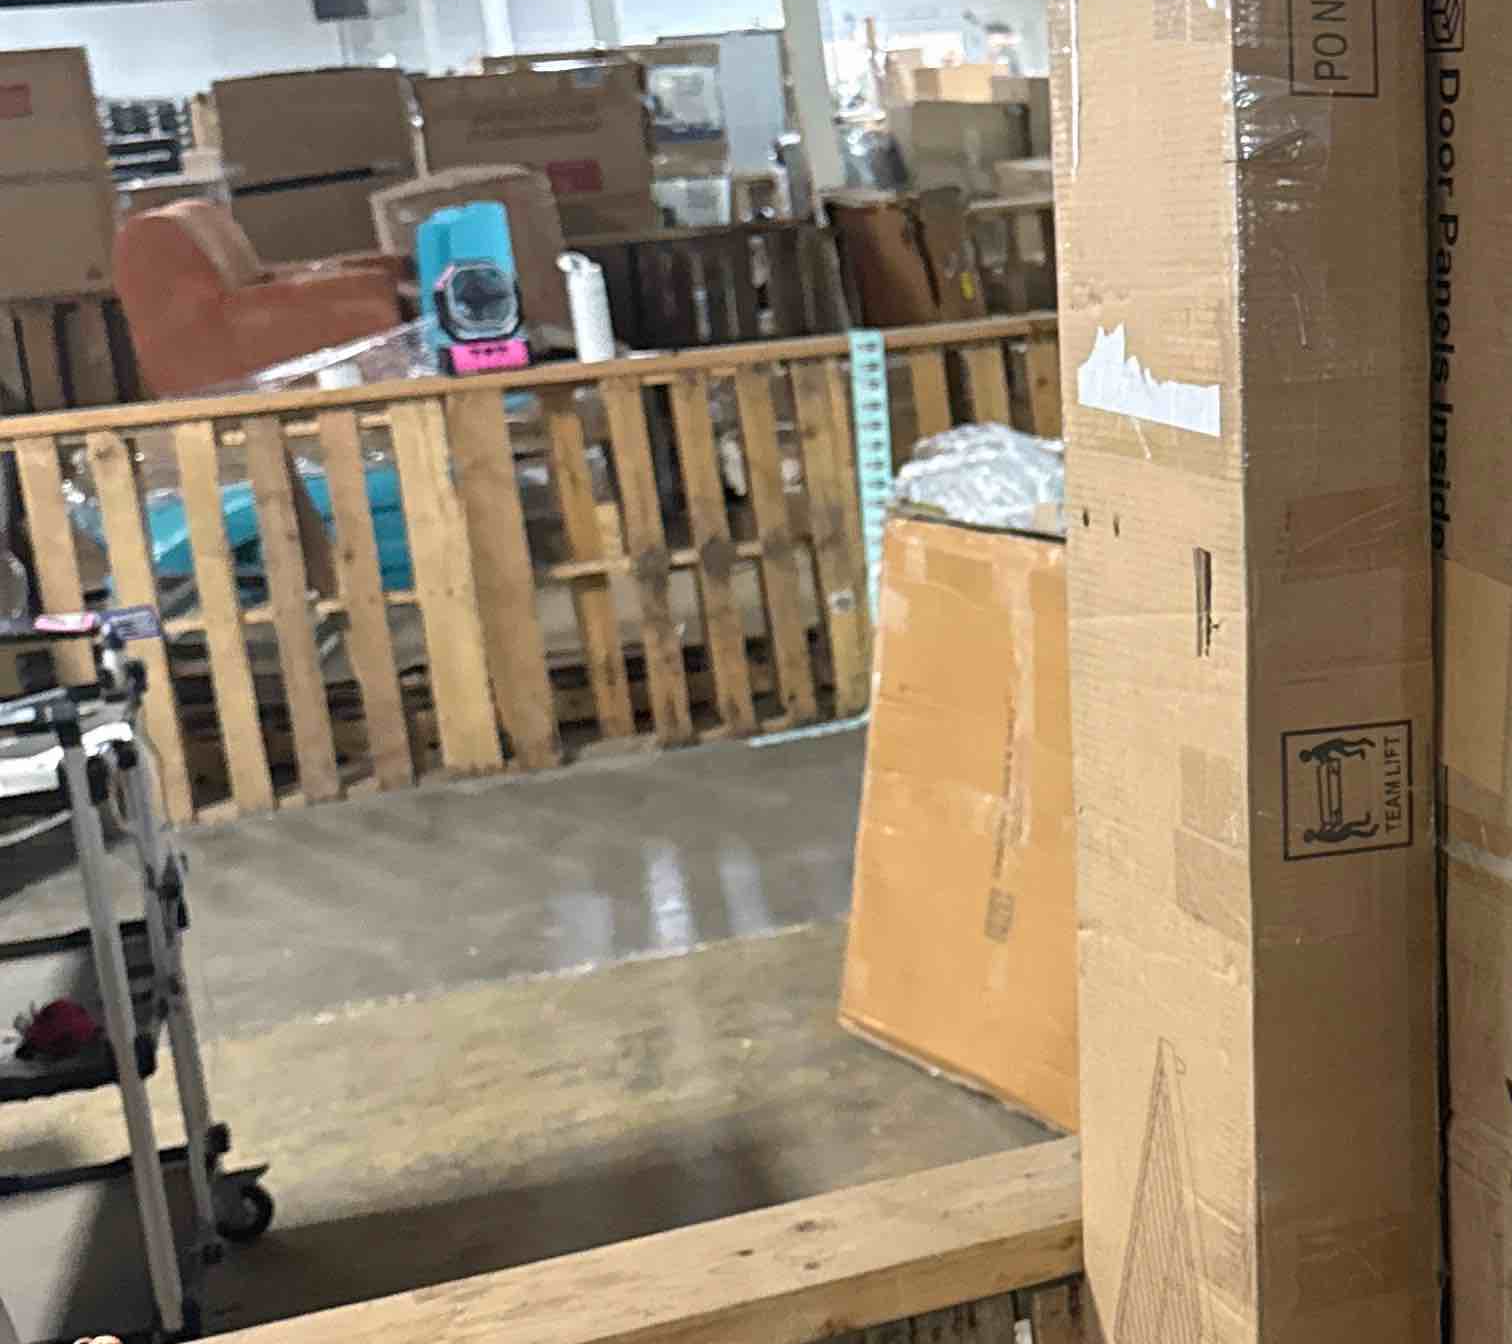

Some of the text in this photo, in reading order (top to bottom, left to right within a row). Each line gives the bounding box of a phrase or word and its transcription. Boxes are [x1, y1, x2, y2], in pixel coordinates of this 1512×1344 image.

[1313, 33, 1350, 81] PO
[1431, 68, 1460, 197] Door
[1431, 213, 1458, 383] Panels
[1385, 780, 1401, 832] TEAM
